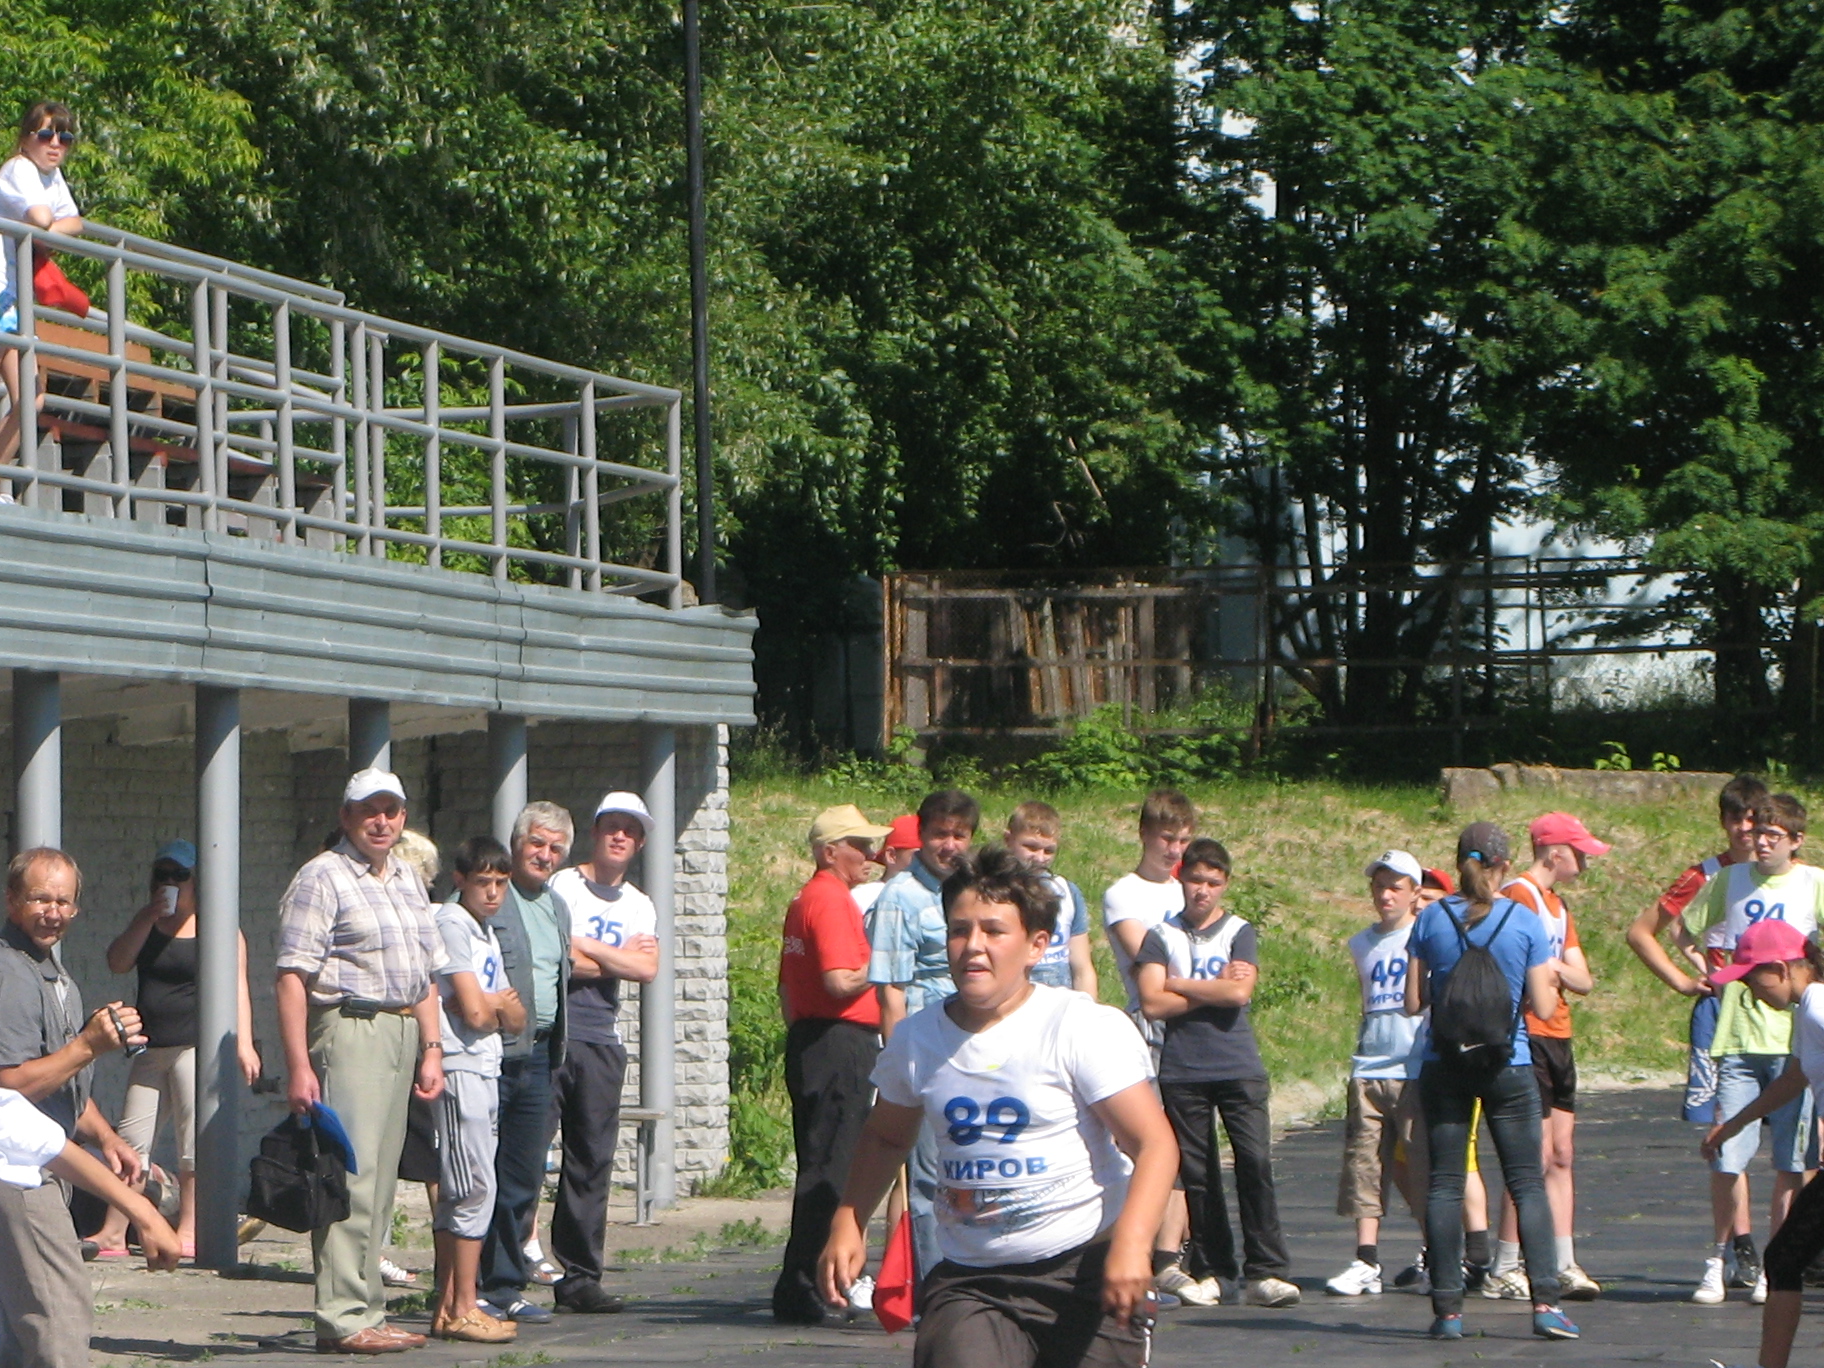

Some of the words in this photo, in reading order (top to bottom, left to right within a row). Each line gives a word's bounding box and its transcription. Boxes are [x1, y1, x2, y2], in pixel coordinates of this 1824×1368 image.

[586, 915, 623, 947] 35
[1371, 958, 1408, 988] 49
[944, 1096, 1030, 1146] 89
